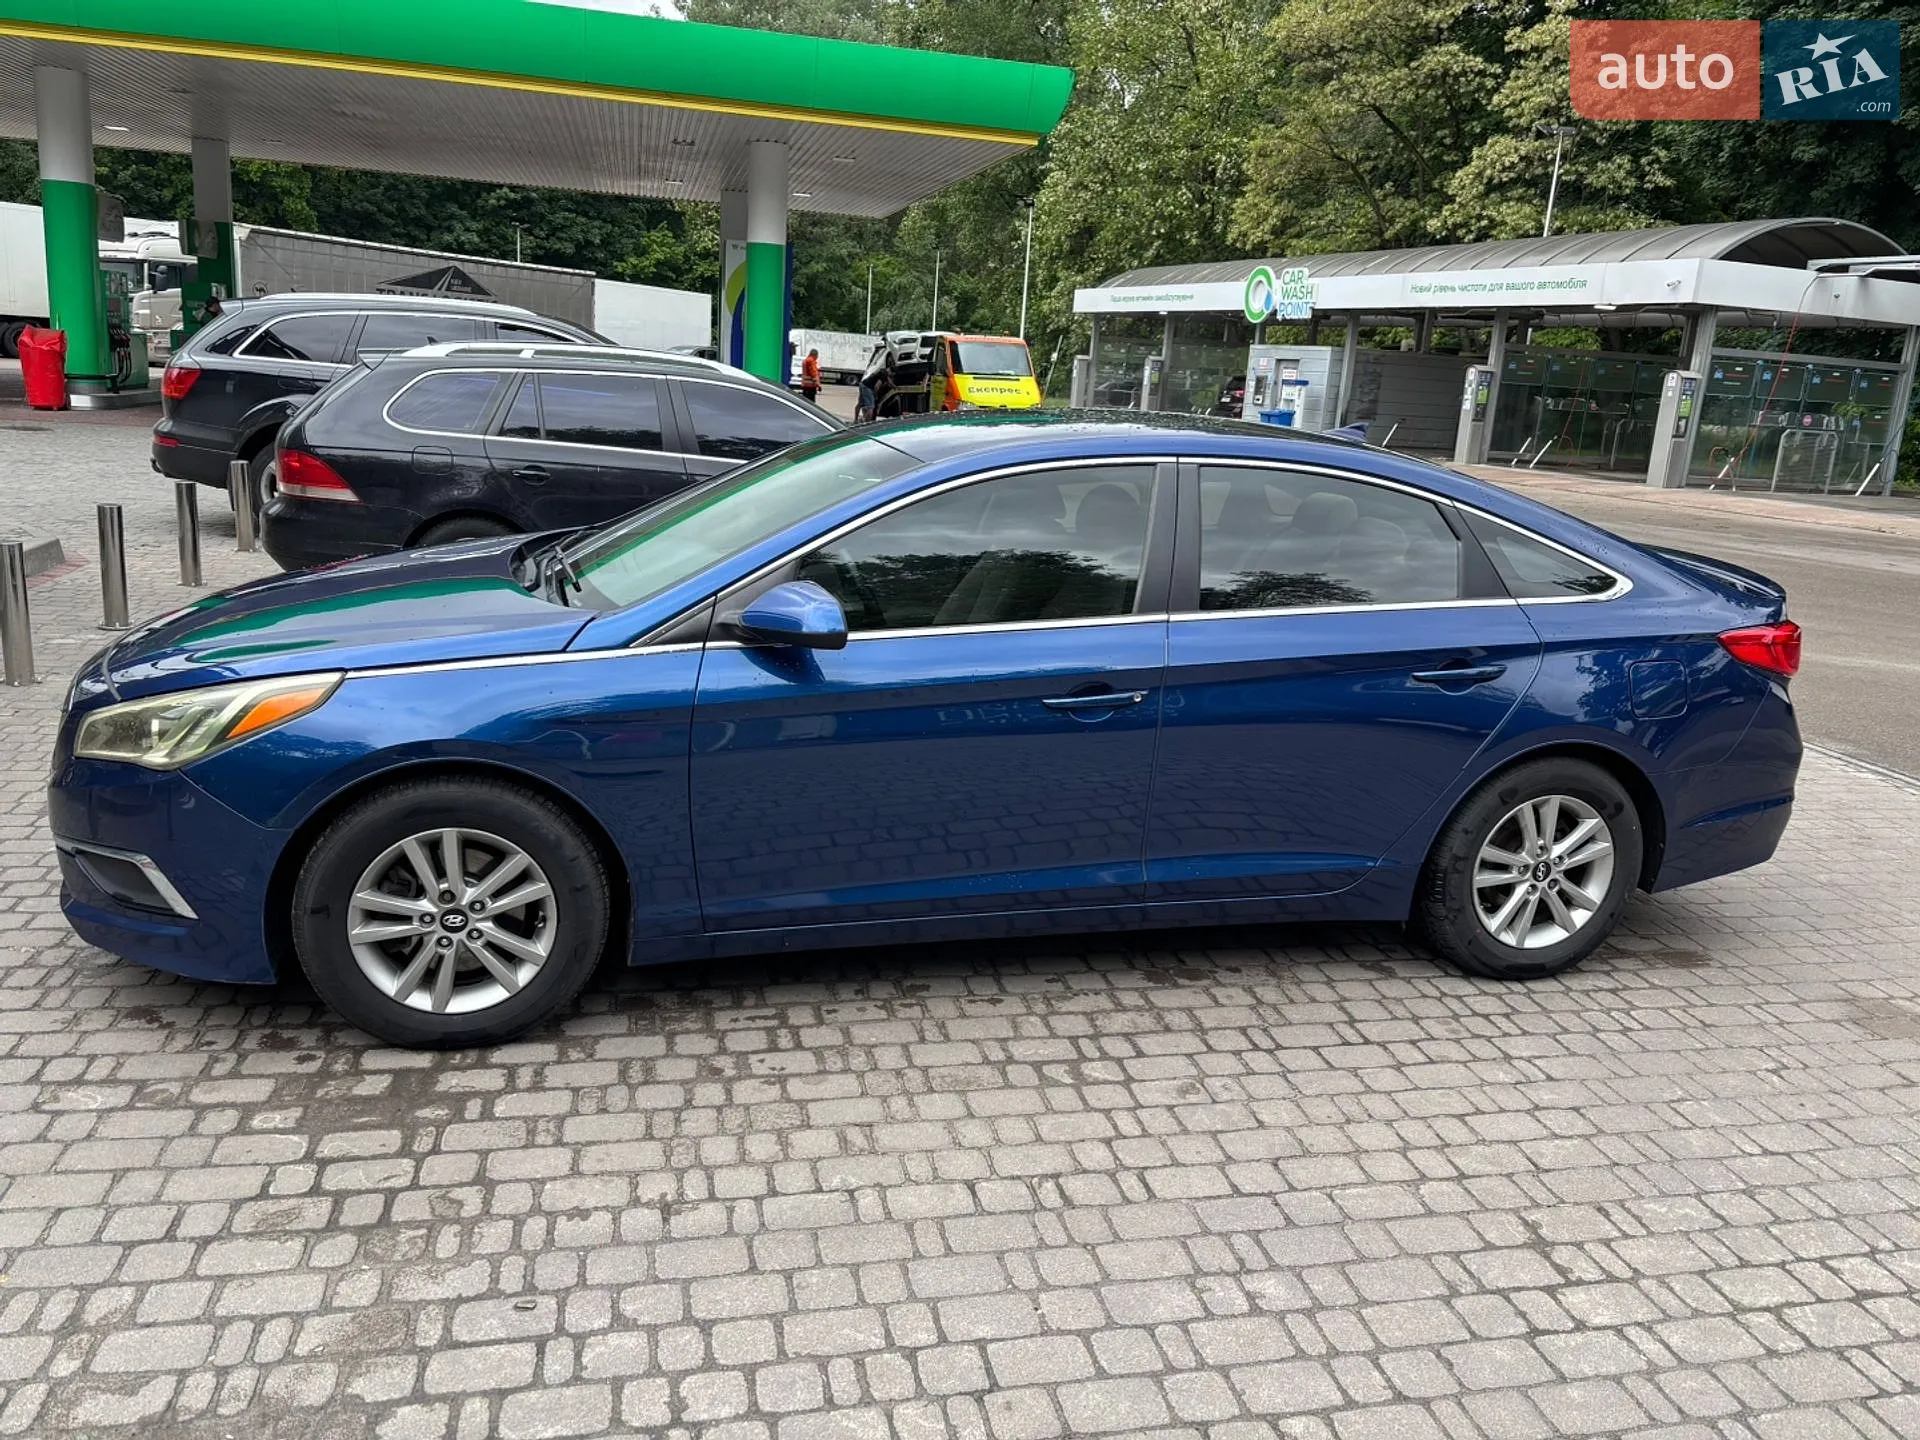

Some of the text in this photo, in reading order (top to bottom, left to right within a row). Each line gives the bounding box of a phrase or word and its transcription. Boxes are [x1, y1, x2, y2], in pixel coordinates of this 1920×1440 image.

[1282, 270, 1304, 285] CAR
[1281, 286, 1314, 300] WASH
[1279, 302, 1310, 316] POINT
